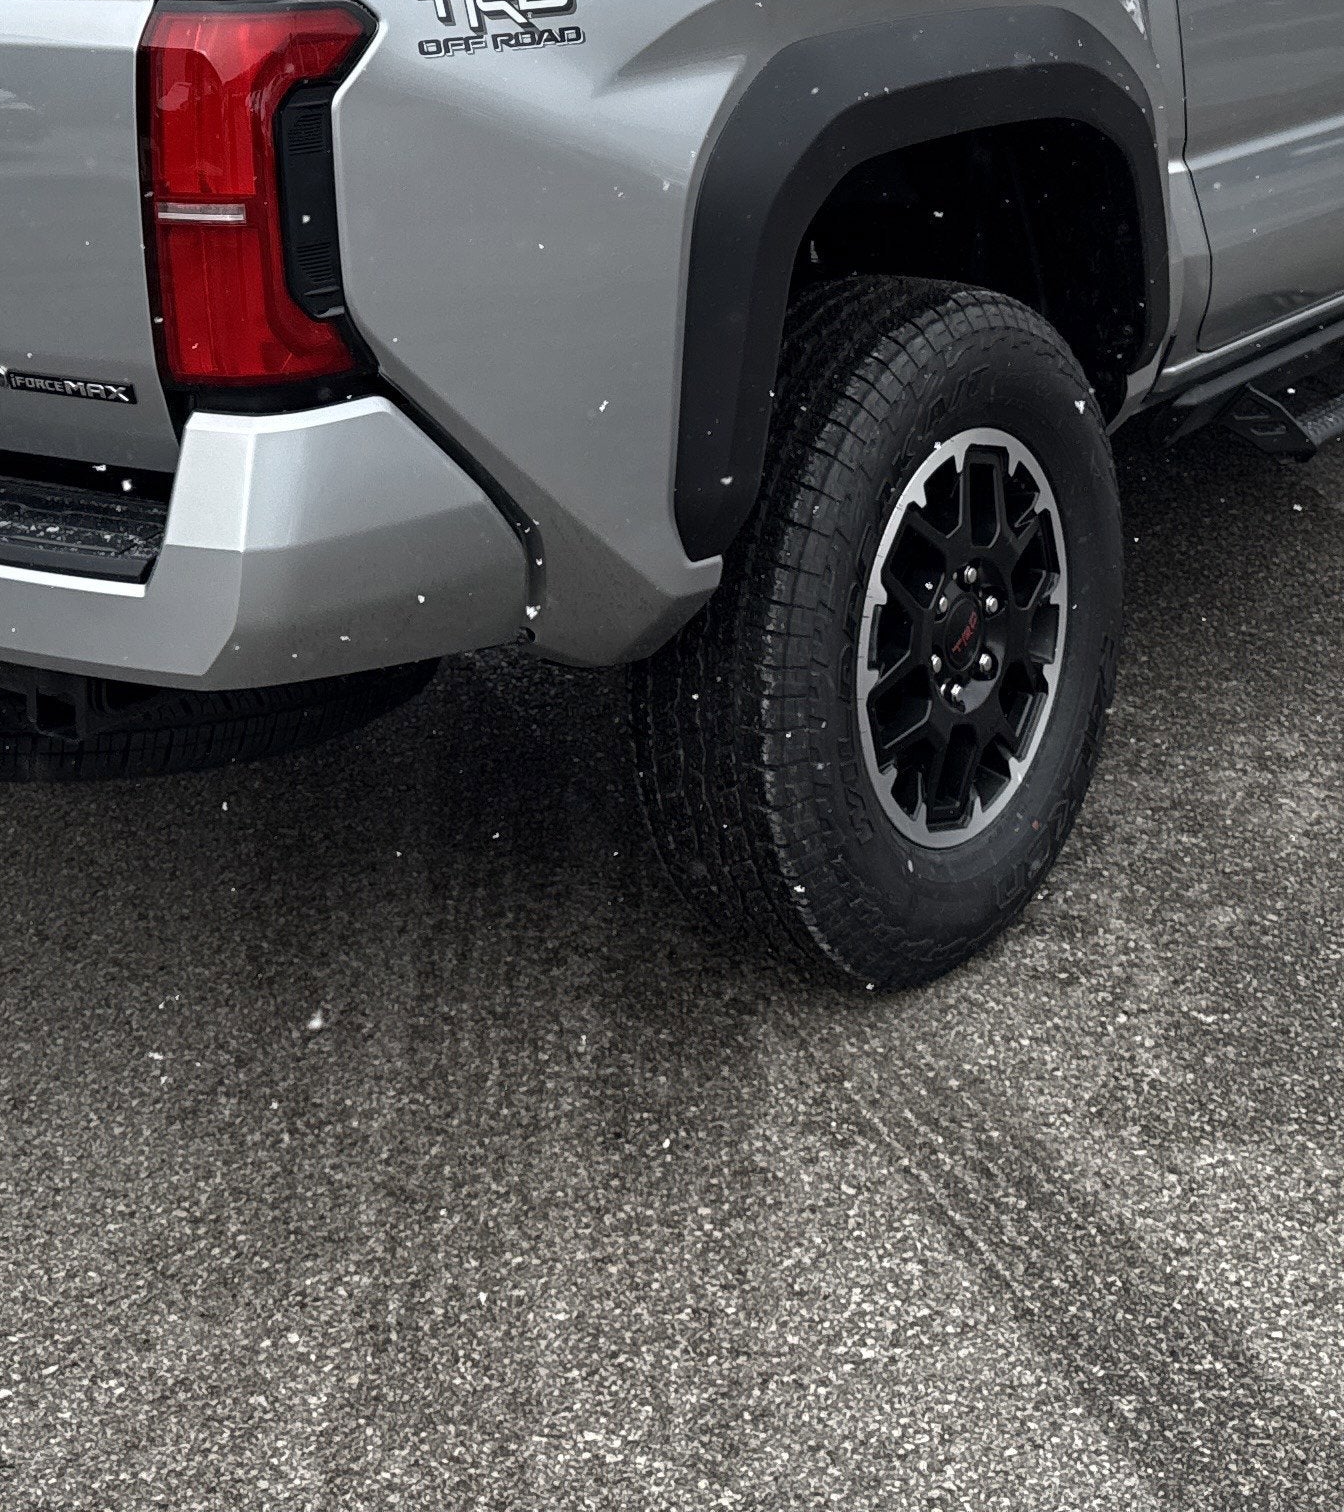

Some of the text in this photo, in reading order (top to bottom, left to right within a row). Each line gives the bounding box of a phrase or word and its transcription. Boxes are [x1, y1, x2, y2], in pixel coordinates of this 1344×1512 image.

[418, 26, 585, 58] OFF ROAD
[64, 380, 129, 402] MAX
[952, 611, 977, 653] TRD
